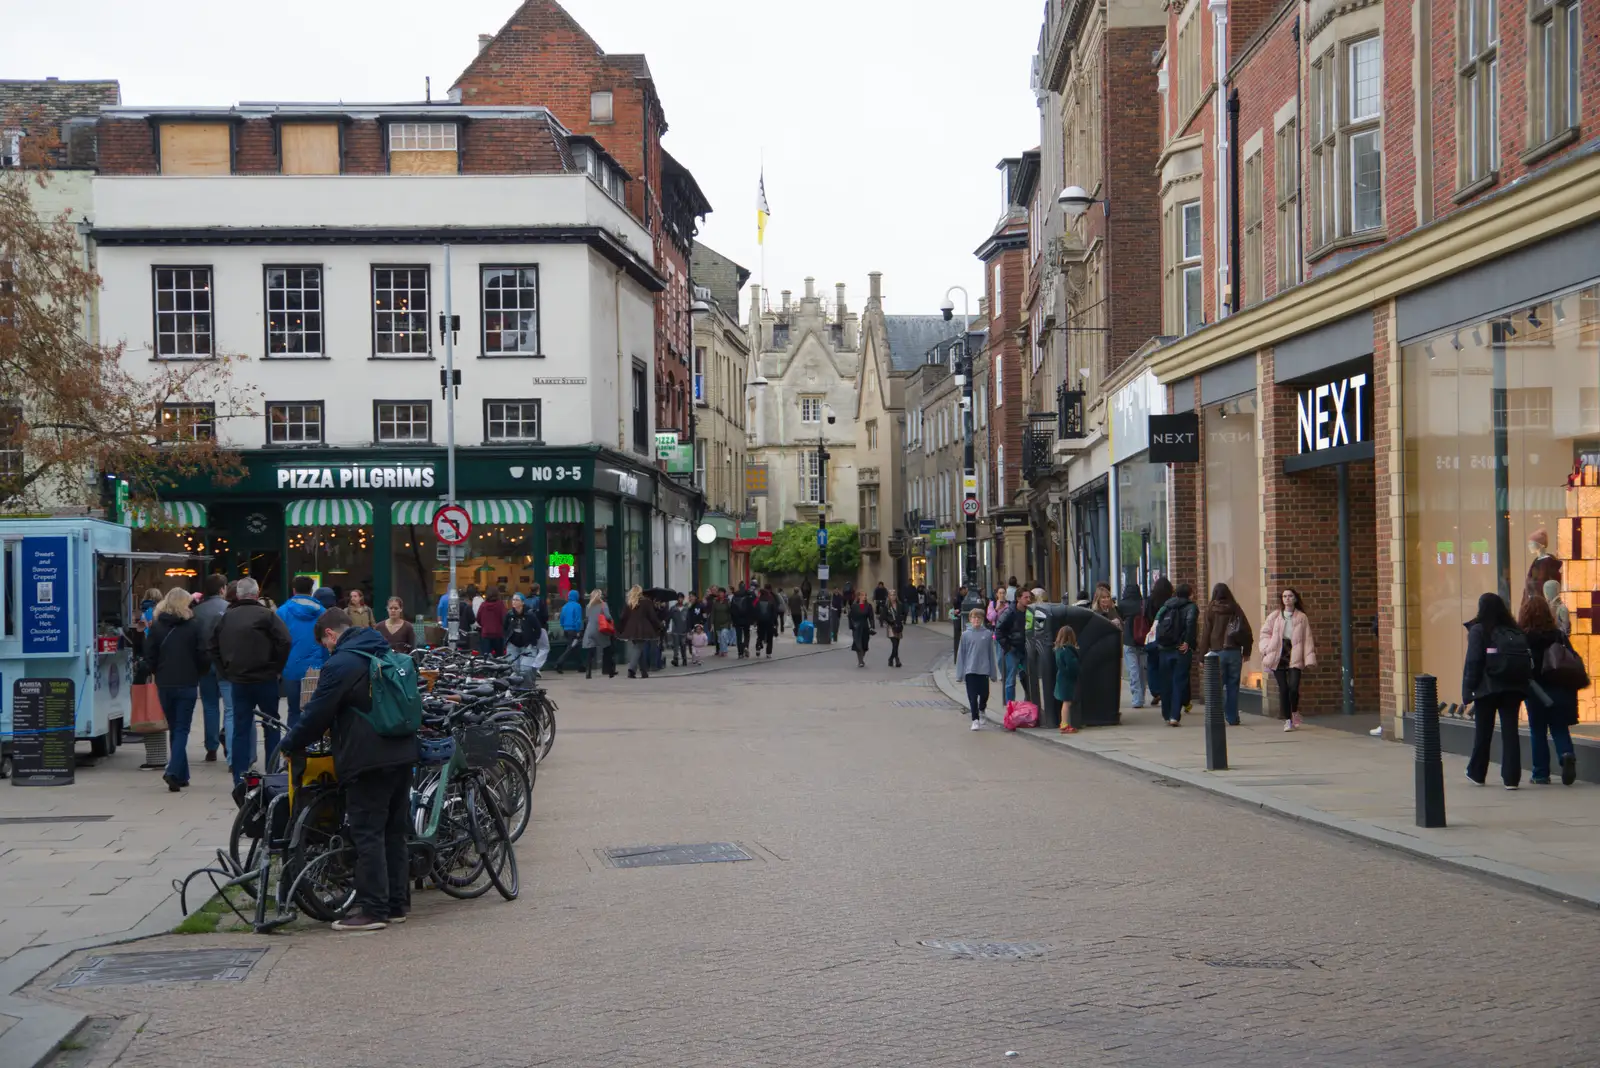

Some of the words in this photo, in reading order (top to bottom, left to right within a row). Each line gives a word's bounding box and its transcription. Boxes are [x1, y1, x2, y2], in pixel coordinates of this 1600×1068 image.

[1297, 373, 1366, 454] NEXT
[1153, 432, 1195, 444] NEXT
[277, 468, 335, 489] PIZZA
[339, 463, 435, 488] PILGRIMS
[532, 466, 552, 481] NO
[555, 466, 582, 480] 3-5
[965, 502, 977, 510] 20
[549, 565, 575, 578] LOE
